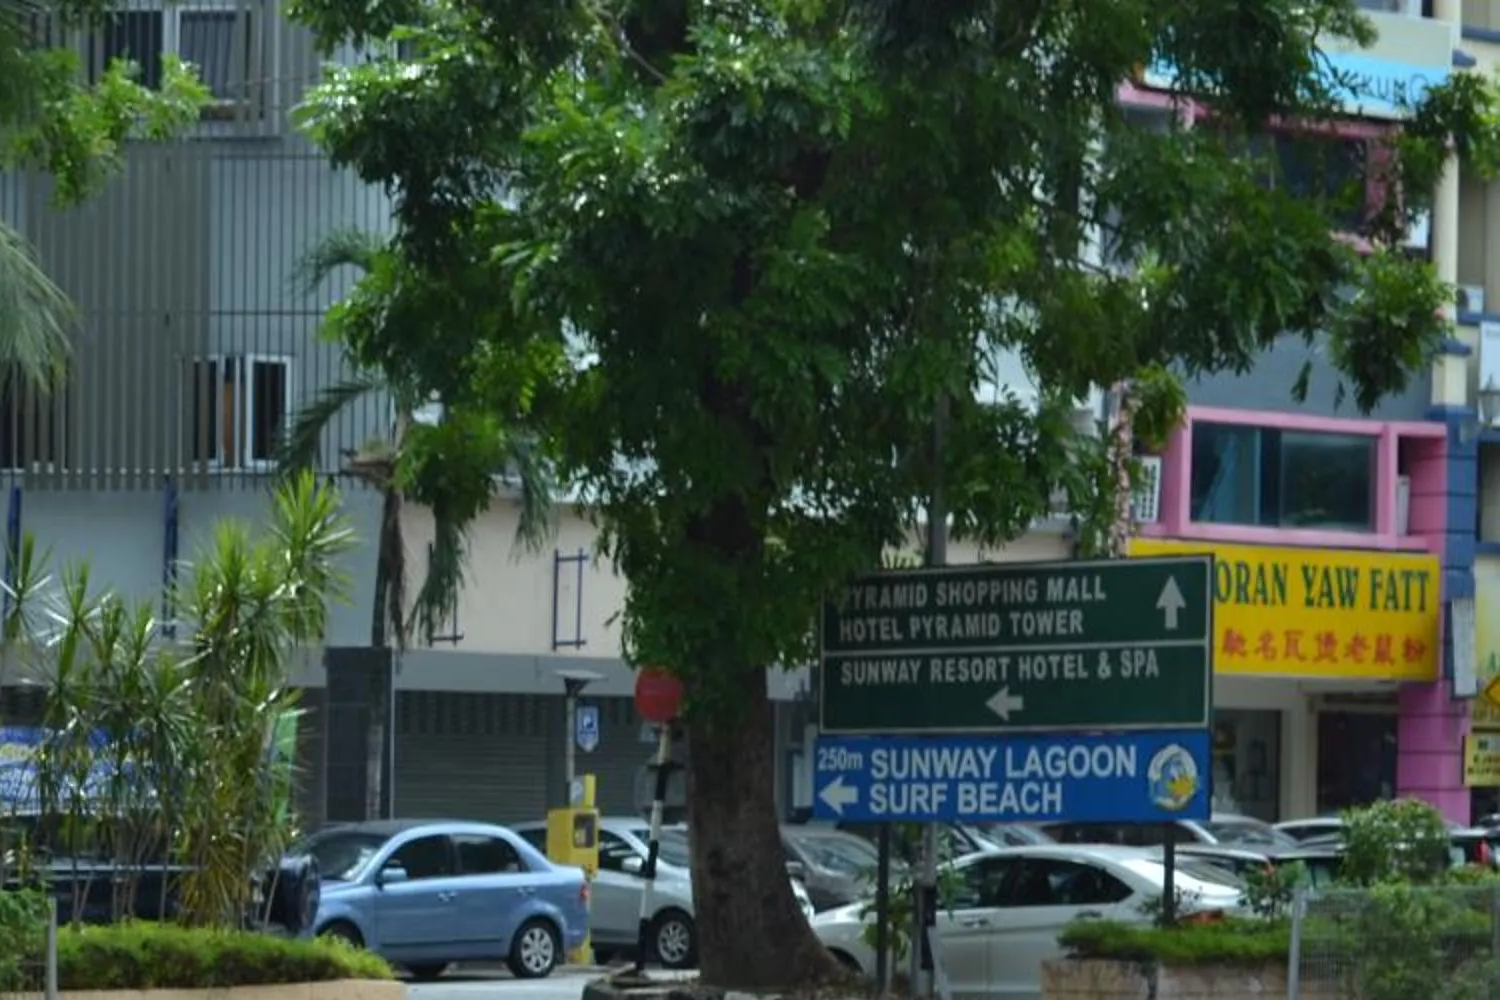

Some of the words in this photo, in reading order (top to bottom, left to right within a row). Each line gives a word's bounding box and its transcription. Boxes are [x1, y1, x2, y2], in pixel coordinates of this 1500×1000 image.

[936, 578, 1038, 607] SHOPPING
[1047, 576, 1106, 602] MALL
[1302, 564, 1359, 609] YAW
[1369, 568, 1430, 612] FATT
[840, 617, 903, 642] HOTEL
[910, 613, 1000, 640] PYRAMID
[1010, 610, 1083, 636] TOWER
[841, 659, 922, 686] SUNWAY
[930, 656, 1010, 682] RESORT
[1019, 654, 1088, 680] HOTEL
[1098, 652, 1112, 678] &
[1120, 649, 1160, 677] SPA
[818, 747, 863, 771] 250m
[871, 748, 996, 779] SUNWAY
[1005, 745, 1137, 777] LAGOON
[870, 784, 947, 814] SURF
[957, 782, 1063, 814] BEACH
